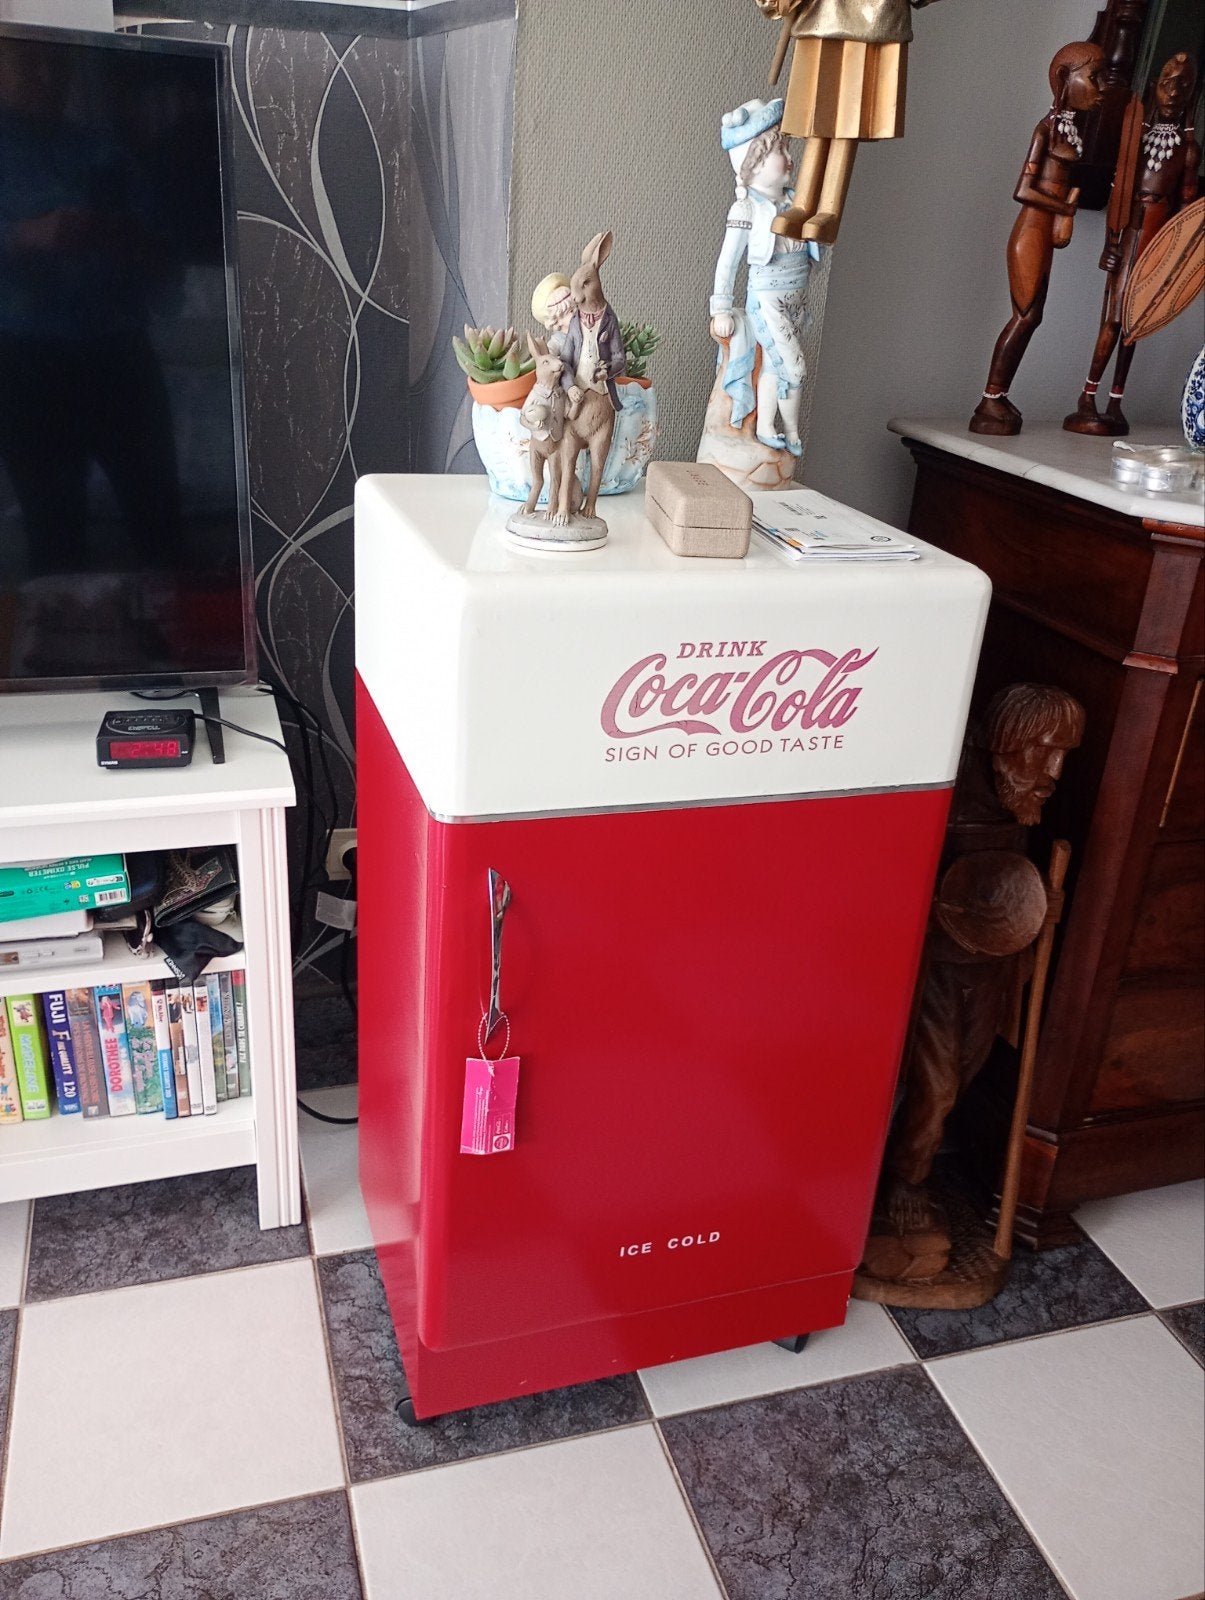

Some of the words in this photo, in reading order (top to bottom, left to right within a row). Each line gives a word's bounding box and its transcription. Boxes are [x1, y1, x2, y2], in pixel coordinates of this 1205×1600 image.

[676, 640, 767, 659] DRINK
[600, 646, 880, 739] Coca-Cola
[605, 745, 658, 762] SIGN
[669, 743, 698, 759] OF
[705, 739, 773, 757] GOOD
[780, 735, 845, 752] TASTE
[28, 865, 65, 877] OXIMETER
[67, 863, 89, 872] PULSE
[49, 993, 64, 1023] FUJI
[62, 1081, 77, 1098] 120
[104, 1038, 123, 1093] DOROTHEE
[620, 1242, 652, 1257] ICE
[667, 1231, 720, 1249] COLD
